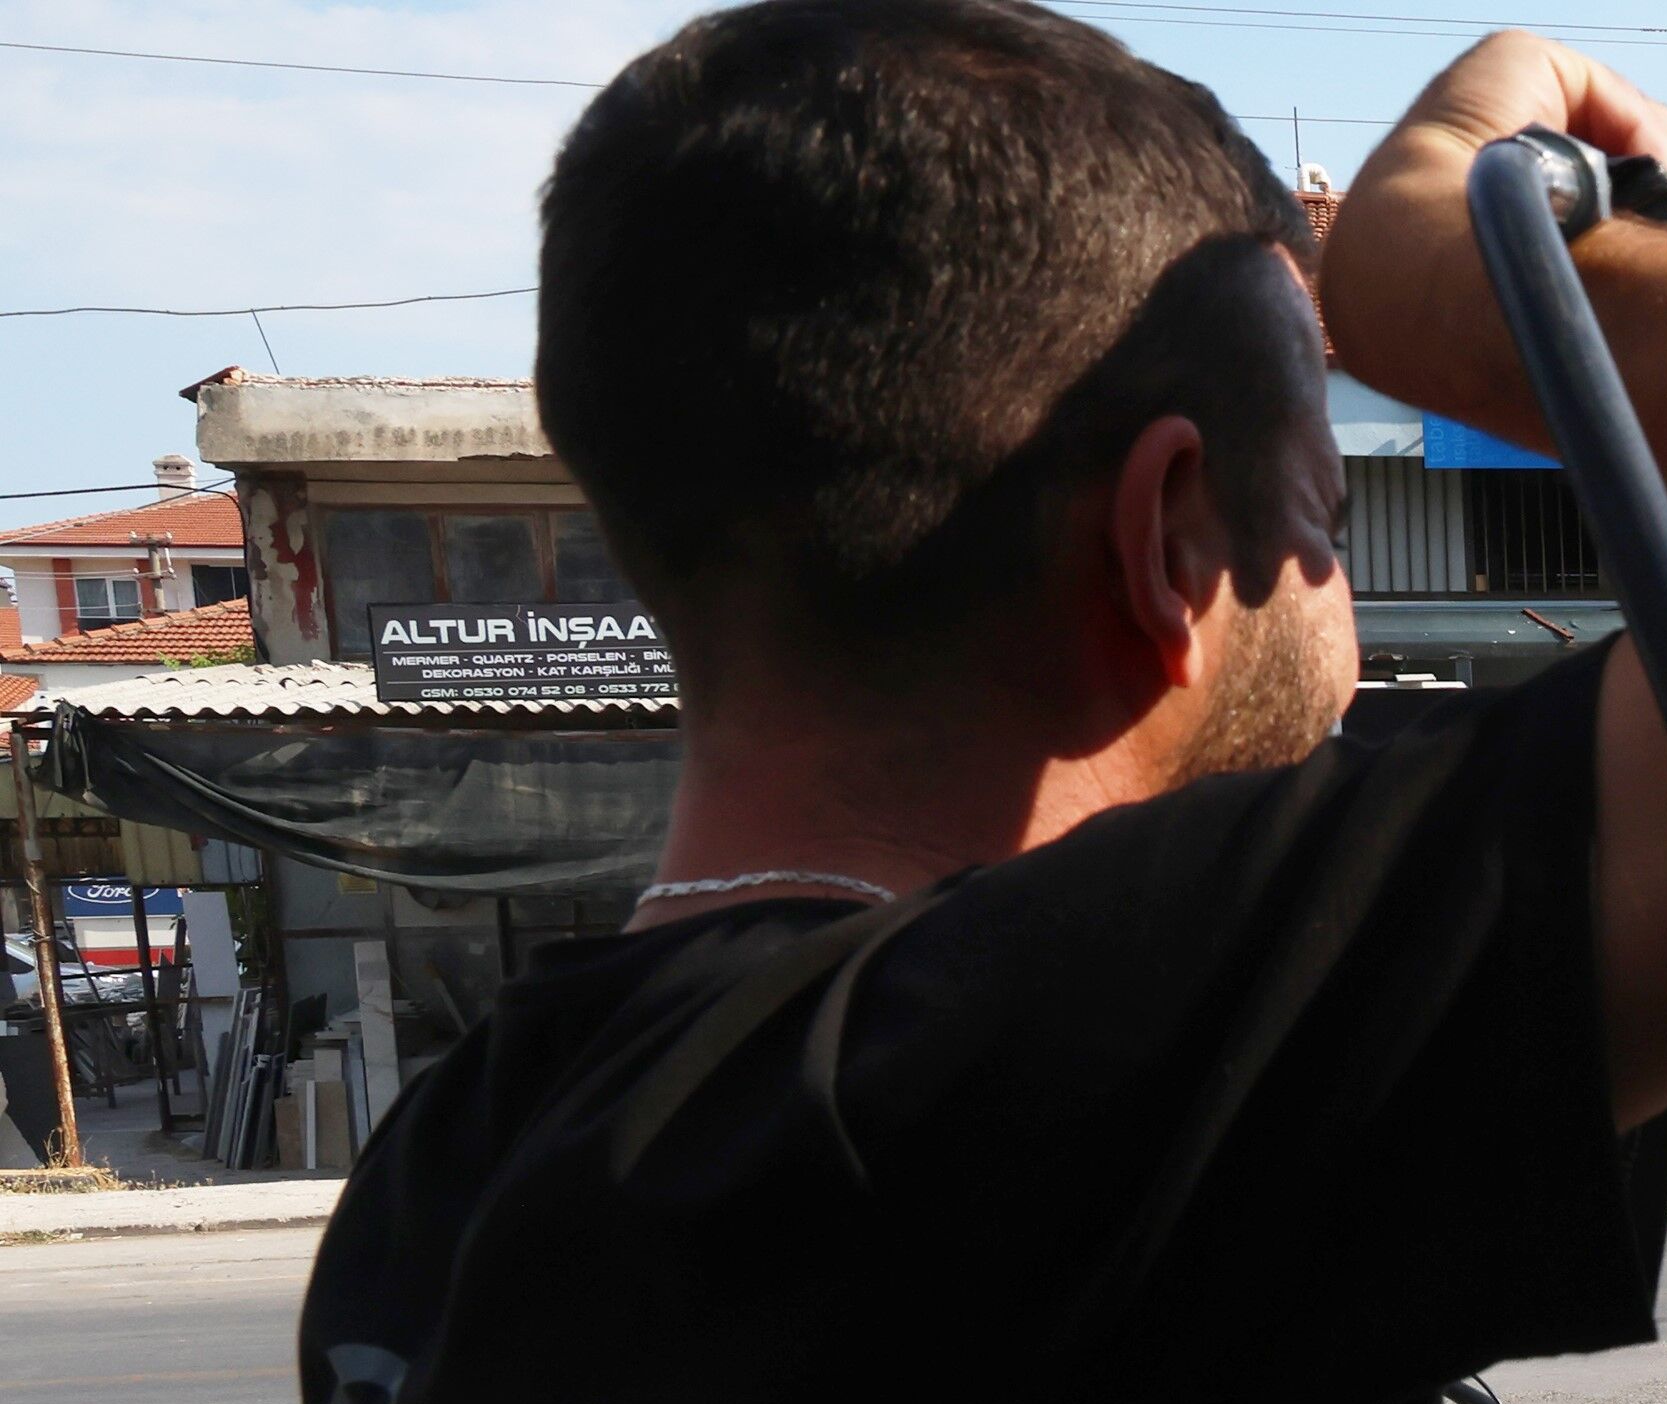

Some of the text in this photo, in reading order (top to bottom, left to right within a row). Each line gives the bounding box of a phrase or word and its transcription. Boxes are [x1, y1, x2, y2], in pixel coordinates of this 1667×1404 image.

[381, 611, 657, 649] ALTUR İNŞAA
[391, 655, 460, 666] MERMER
[472, 654, 534, 665] QUARTZ
[546, 652, 627, 663] PORSELEN
[422, 667, 525, 679] DEKORASYON
[537, 666, 567, 677] KAT
[421, 688, 459, 699] GSM:
[462, 687, 504, 698] 0530
[507, 686, 538, 697] 074
[541, 685, 561, 696] 52
[564, 684, 586, 695] 08
[598, 683, 638, 694] 0533
[641, 682, 670, 693] 772
